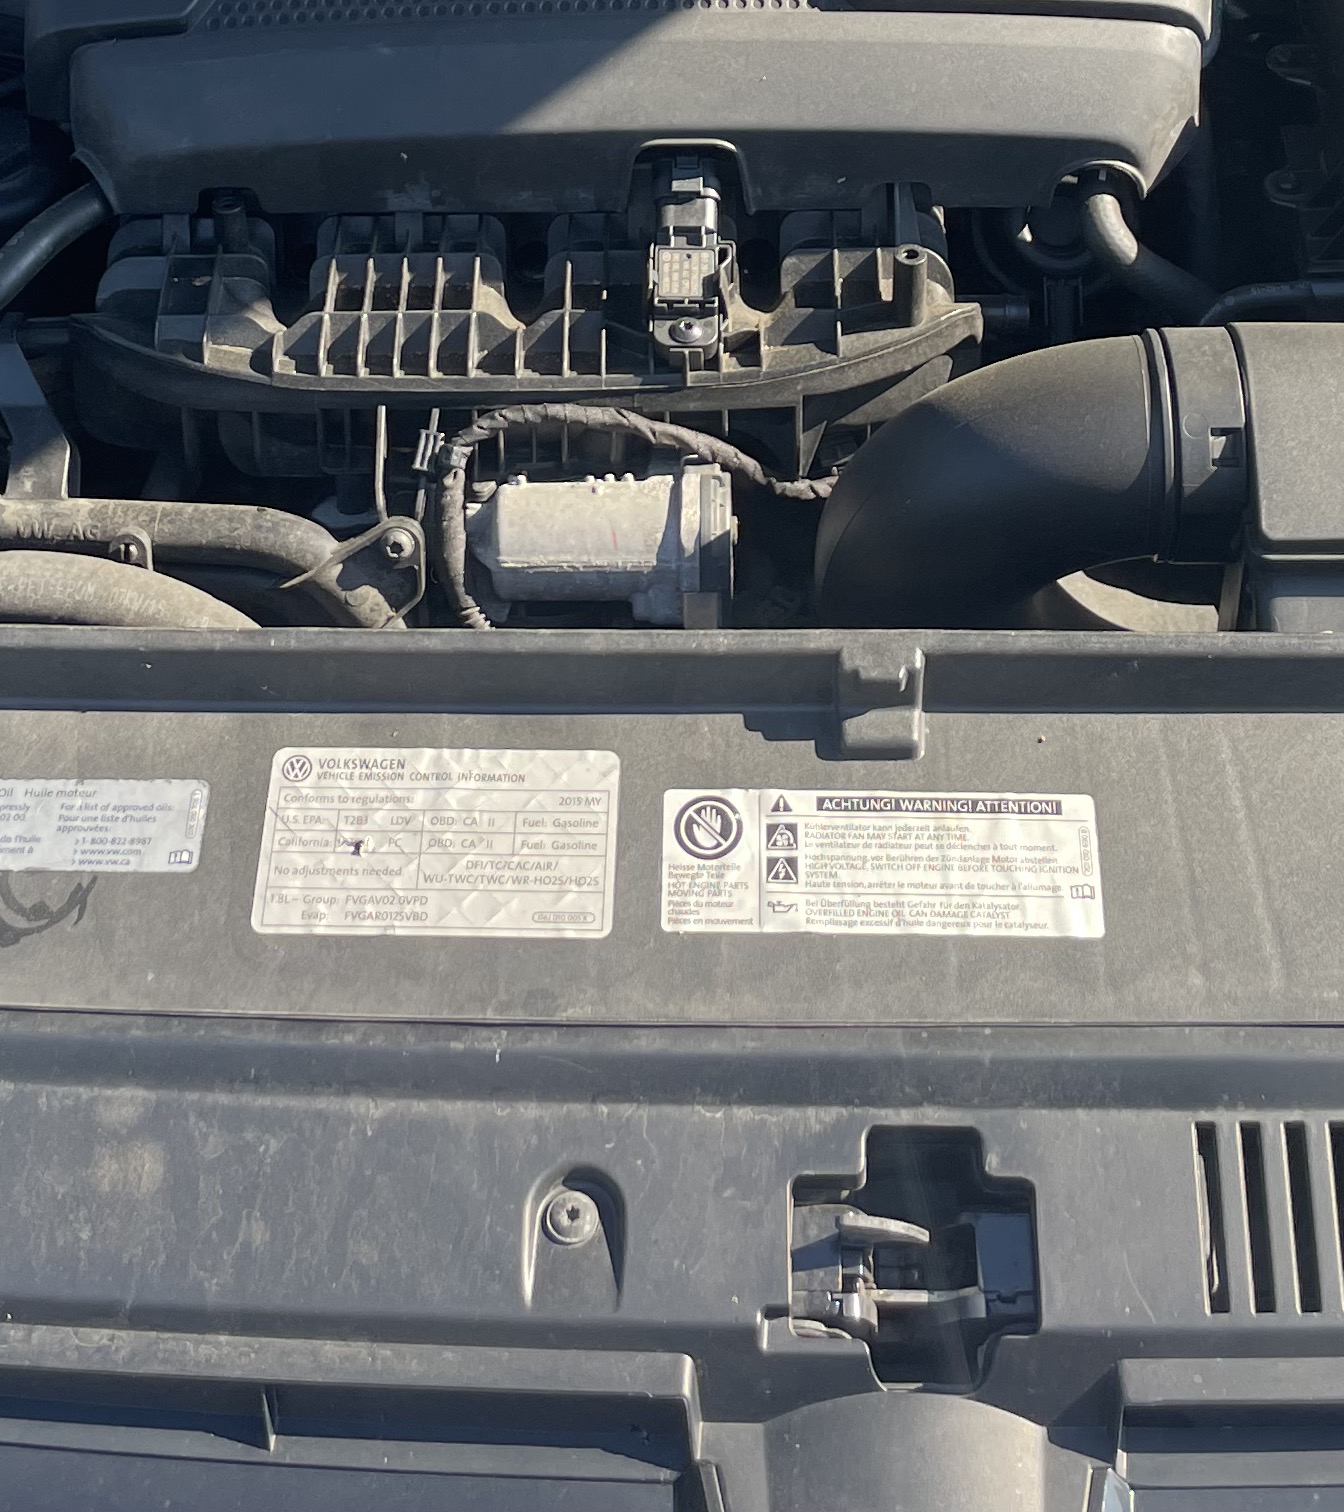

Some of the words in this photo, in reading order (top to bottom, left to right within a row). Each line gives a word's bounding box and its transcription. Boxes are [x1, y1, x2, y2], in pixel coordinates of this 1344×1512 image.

[318, 758, 406, 770] VOLKSWAGEN
[316, 771, 355, 781] VEHICLE
[358, 772, 405, 781] EMISSION
[409, 772, 453, 782] CONTROL
[458, 770, 526, 783] INFORMATION
[24, 788, 54, 798] Huile
[284, 793, 335, 804] Conforms
[338, 795, 349, 804] to
[351, 794, 414, 806] regulations:
[558, 796, 583, 806] 2015
[584, 797, 602, 806] MY
[61, 803, 75, 811] For
[84, 803, 98, 811] list
[100, 803, 111, 811] of
[112, 803, 154, 813] approved
[822, 798, 896, 811] ACHTUNG!
[900, 799, 973, 812] WARNING!
[976, 800, 1057, 814] ATTENTION!
[58, 814, 79, 822] Pour
[100, 815, 120, 823] liste
[122, 815, 157, 823] d'huiles
[281, 816, 301, 825] U.S.
[344, 816, 369, 825] T2B3
[390, 816, 413, 826] LDV
[463, 817, 478, 827] CA
[552, 818, 600, 830] Gasoline
[872, 823, 893, 832] kann
[894, 824, 931, 835] jederzeit
[0, 834, 12, 843] de
[804, 832, 846, 840] RADIATOR
[848, 832, 865, 840] FAN
[866, 832, 886, 840] MAY
[888, 832, 912, 841] START
[914, 833, 925, 841] AT
[388, 838, 402, 847] PC
[460, 839, 477, 849] CA
[552, 840, 598, 852] Gasoline
[874, 842, 912, 850] radiateur
[914, 842, 933, 852] peut
[78, 858, 130, 866] www.vw.ca
[886, 854, 924, 862] Berühren
[926, 855, 939, 863] der
[992, 856, 1018, 864] Motor
[274, 866, 290, 875] No
[292, 866, 359, 878] adjustments
[362, 866, 403, 877] needed
[668, 863, 696, 871] Heisse
[697, 863, 742, 872] Motorteile
[923, 864, 955, 872] ENGINE
[958, 864, 989, 873] BEFORE
[992, 865, 1037, 873] TOUCHING
[1040, 866, 1080, 874] IGNITION
[668, 872, 705, 880] Bewegte
[706, 872, 725, 880] Teile
[688, 882, 721, 890] ENGINE
[724, 882, 750, 890] PARTS
[804, 880, 831, 889] Haute
[964, 882, 975, 890] de
[976, 882, 1010, 891] toucher
[668, 890, 705, 898] MOVING
[708, 890, 733, 898] PARTS
[693, 900, 704, 908] du
[806, 899, 818, 907] Bei
[874, 900, 905, 908] besteht
[907, 900, 936, 908] Gefahr
[940, 901, 953, 909] für
[954, 902, 971, 910] den
[668, 908, 700, 916] chaudes
[806, 908, 855, 917] OVERFILLED
[857, 910, 889, 918] ENGINE
[892, 910, 906, 918] OIL
[908, 910, 927, 918] CAN
[930, 910, 969, 919] DAMAGE
[705, 918, 754, 926] mouvement
[806, 918, 859, 927] Remplissage
[860, 918, 893, 927] excessif
[926, 920, 971, 930] dangereux
[972, 921, 993, 930] pour
